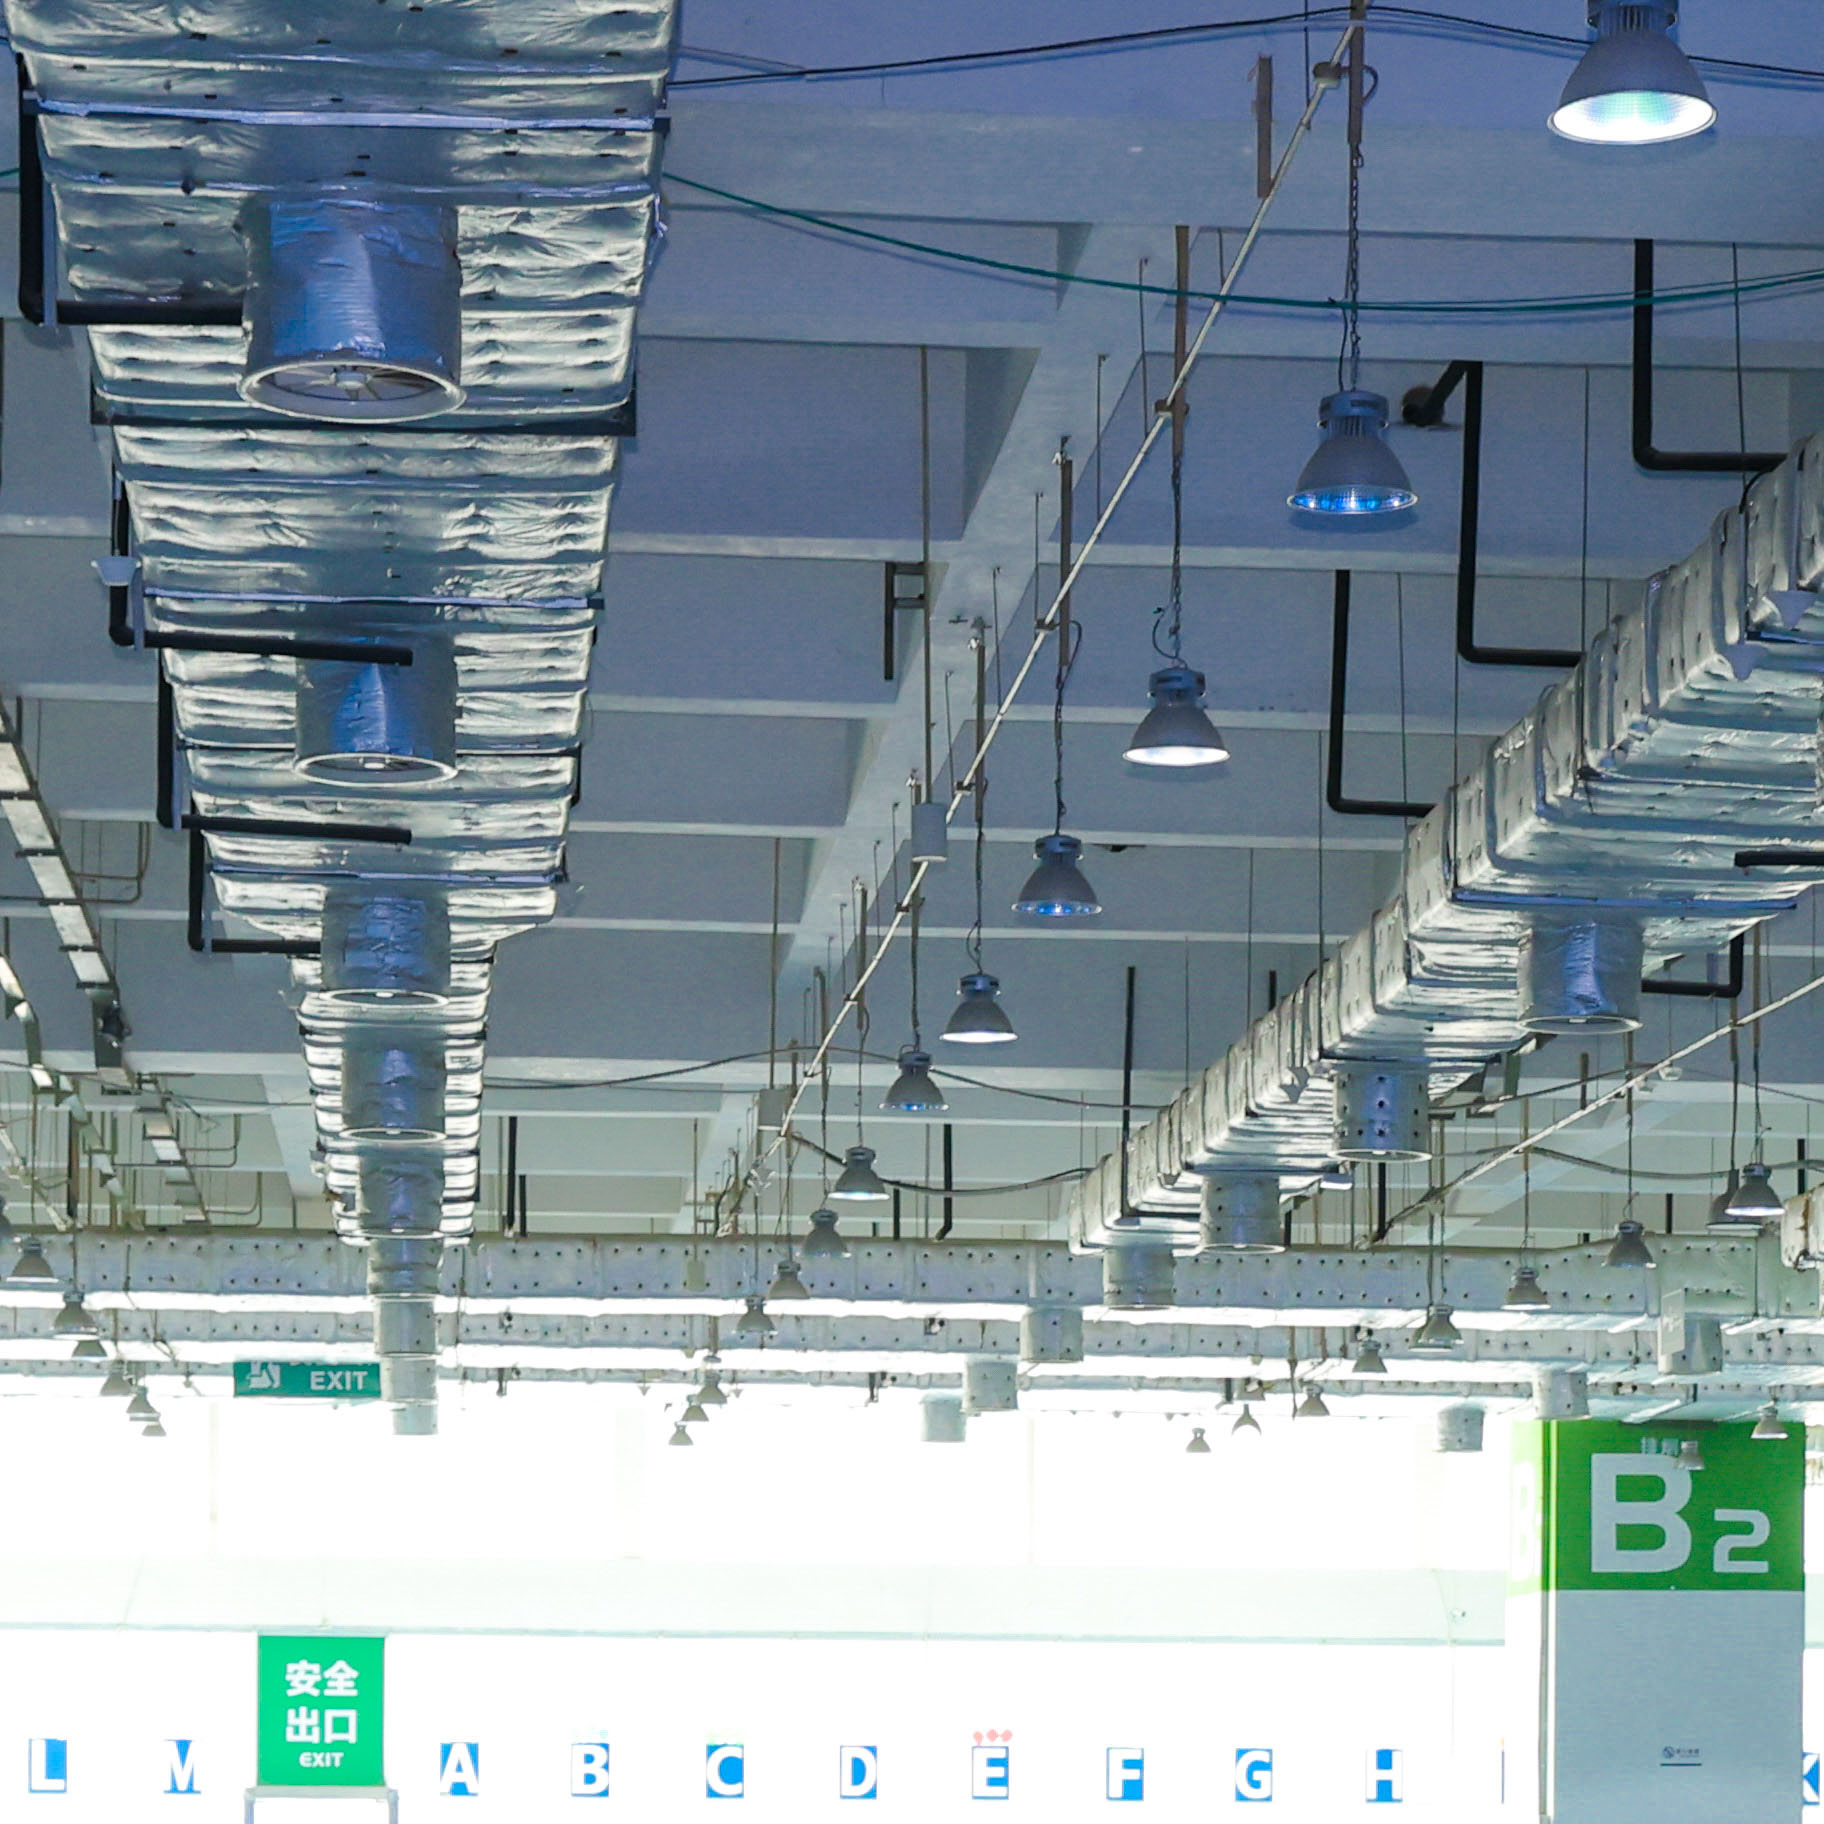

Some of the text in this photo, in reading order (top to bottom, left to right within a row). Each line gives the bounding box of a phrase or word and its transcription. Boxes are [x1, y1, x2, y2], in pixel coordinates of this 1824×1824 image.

[310, 1370, 368, 1391] EXIT
[1590, 1453, 1771, 1574] B2
[285, 1659, 360, 1697] 安全
[285, 1706, 358, 1743] 出口
[28, 1739, 68, 1793] L
[164, 1739, 201, 1793] M
[299, 1752, 345, 1768] EXIT
[440, 1743, 479, 1796] A
[571, 1743, 610, 1798] B
[706, 1745, 745, 1799] C
[840, 1745, 878, 1799] D
[972, 1746, 1010, 1800] E
[1106, 1747, 1144, 1801] F
[1235, 1748, 1273, 1802] G
[1365, 1749, 1403, 1803] H
